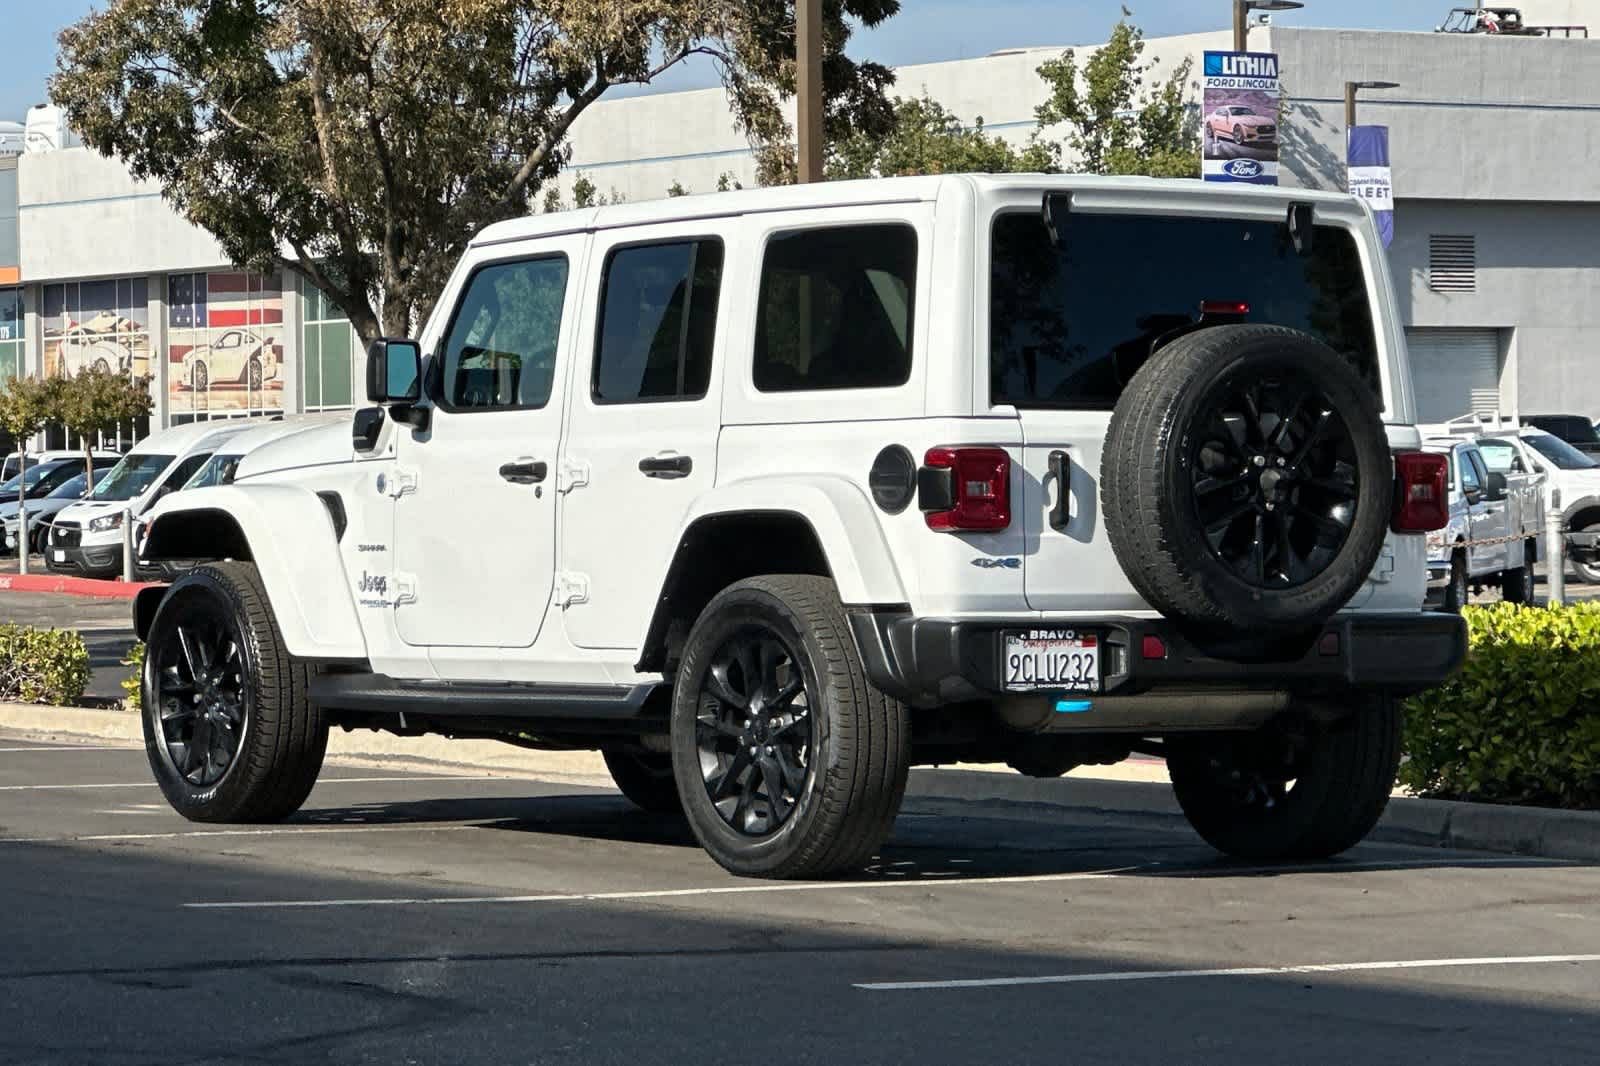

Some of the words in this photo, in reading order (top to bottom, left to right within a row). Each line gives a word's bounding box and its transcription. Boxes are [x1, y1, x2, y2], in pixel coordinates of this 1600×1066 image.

[1222, 56, 1276, 76] LITHIA
[1207, 78, 1236, 87] FORD
[1237, 79, 1276, 89] LINCOLN
[1231, 160, 1257, 175] Ford
[1350, 187, 1390, 198] FLEET
[358, 570, 386, 596] Jeep
[1029, 629, 1075, 640] BRAVO
[1010, 653, 1095, 682] 9CLU232
